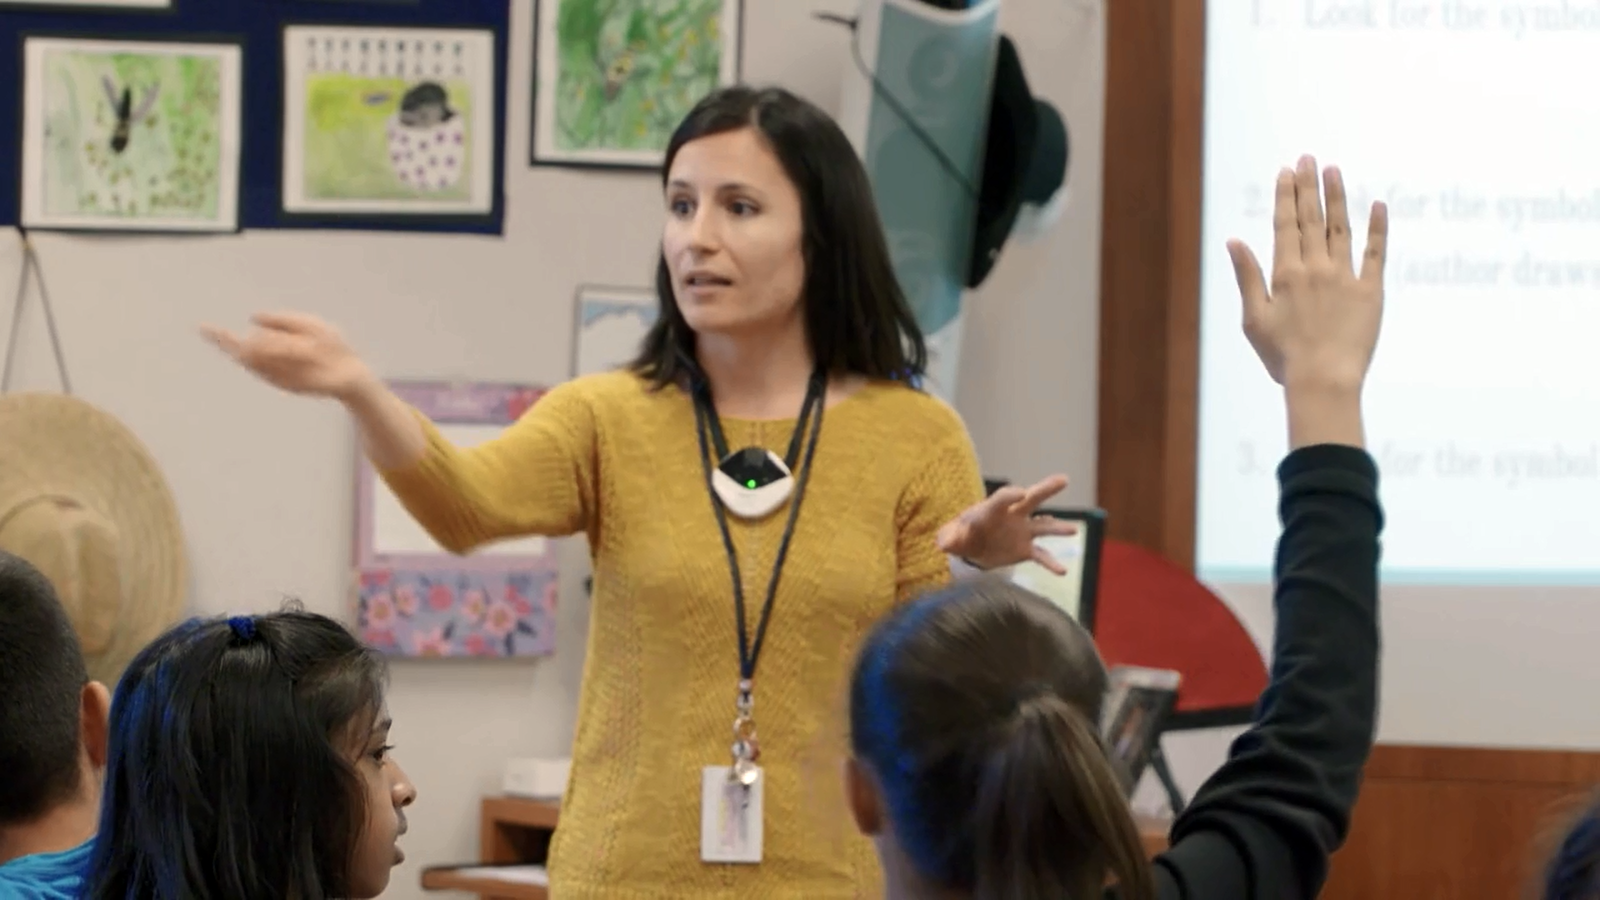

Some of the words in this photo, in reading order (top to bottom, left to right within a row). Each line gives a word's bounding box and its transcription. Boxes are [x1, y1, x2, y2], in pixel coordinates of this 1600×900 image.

[1302, 0, 1378, 30] Look
[1387, 0, 1431, 30] for
[1440, 0, 1486, 30] the
[1439, 183, 1486, 220] the
[1382, 440, 1424, 477] for
[1434, 440, 1482, 477] the
